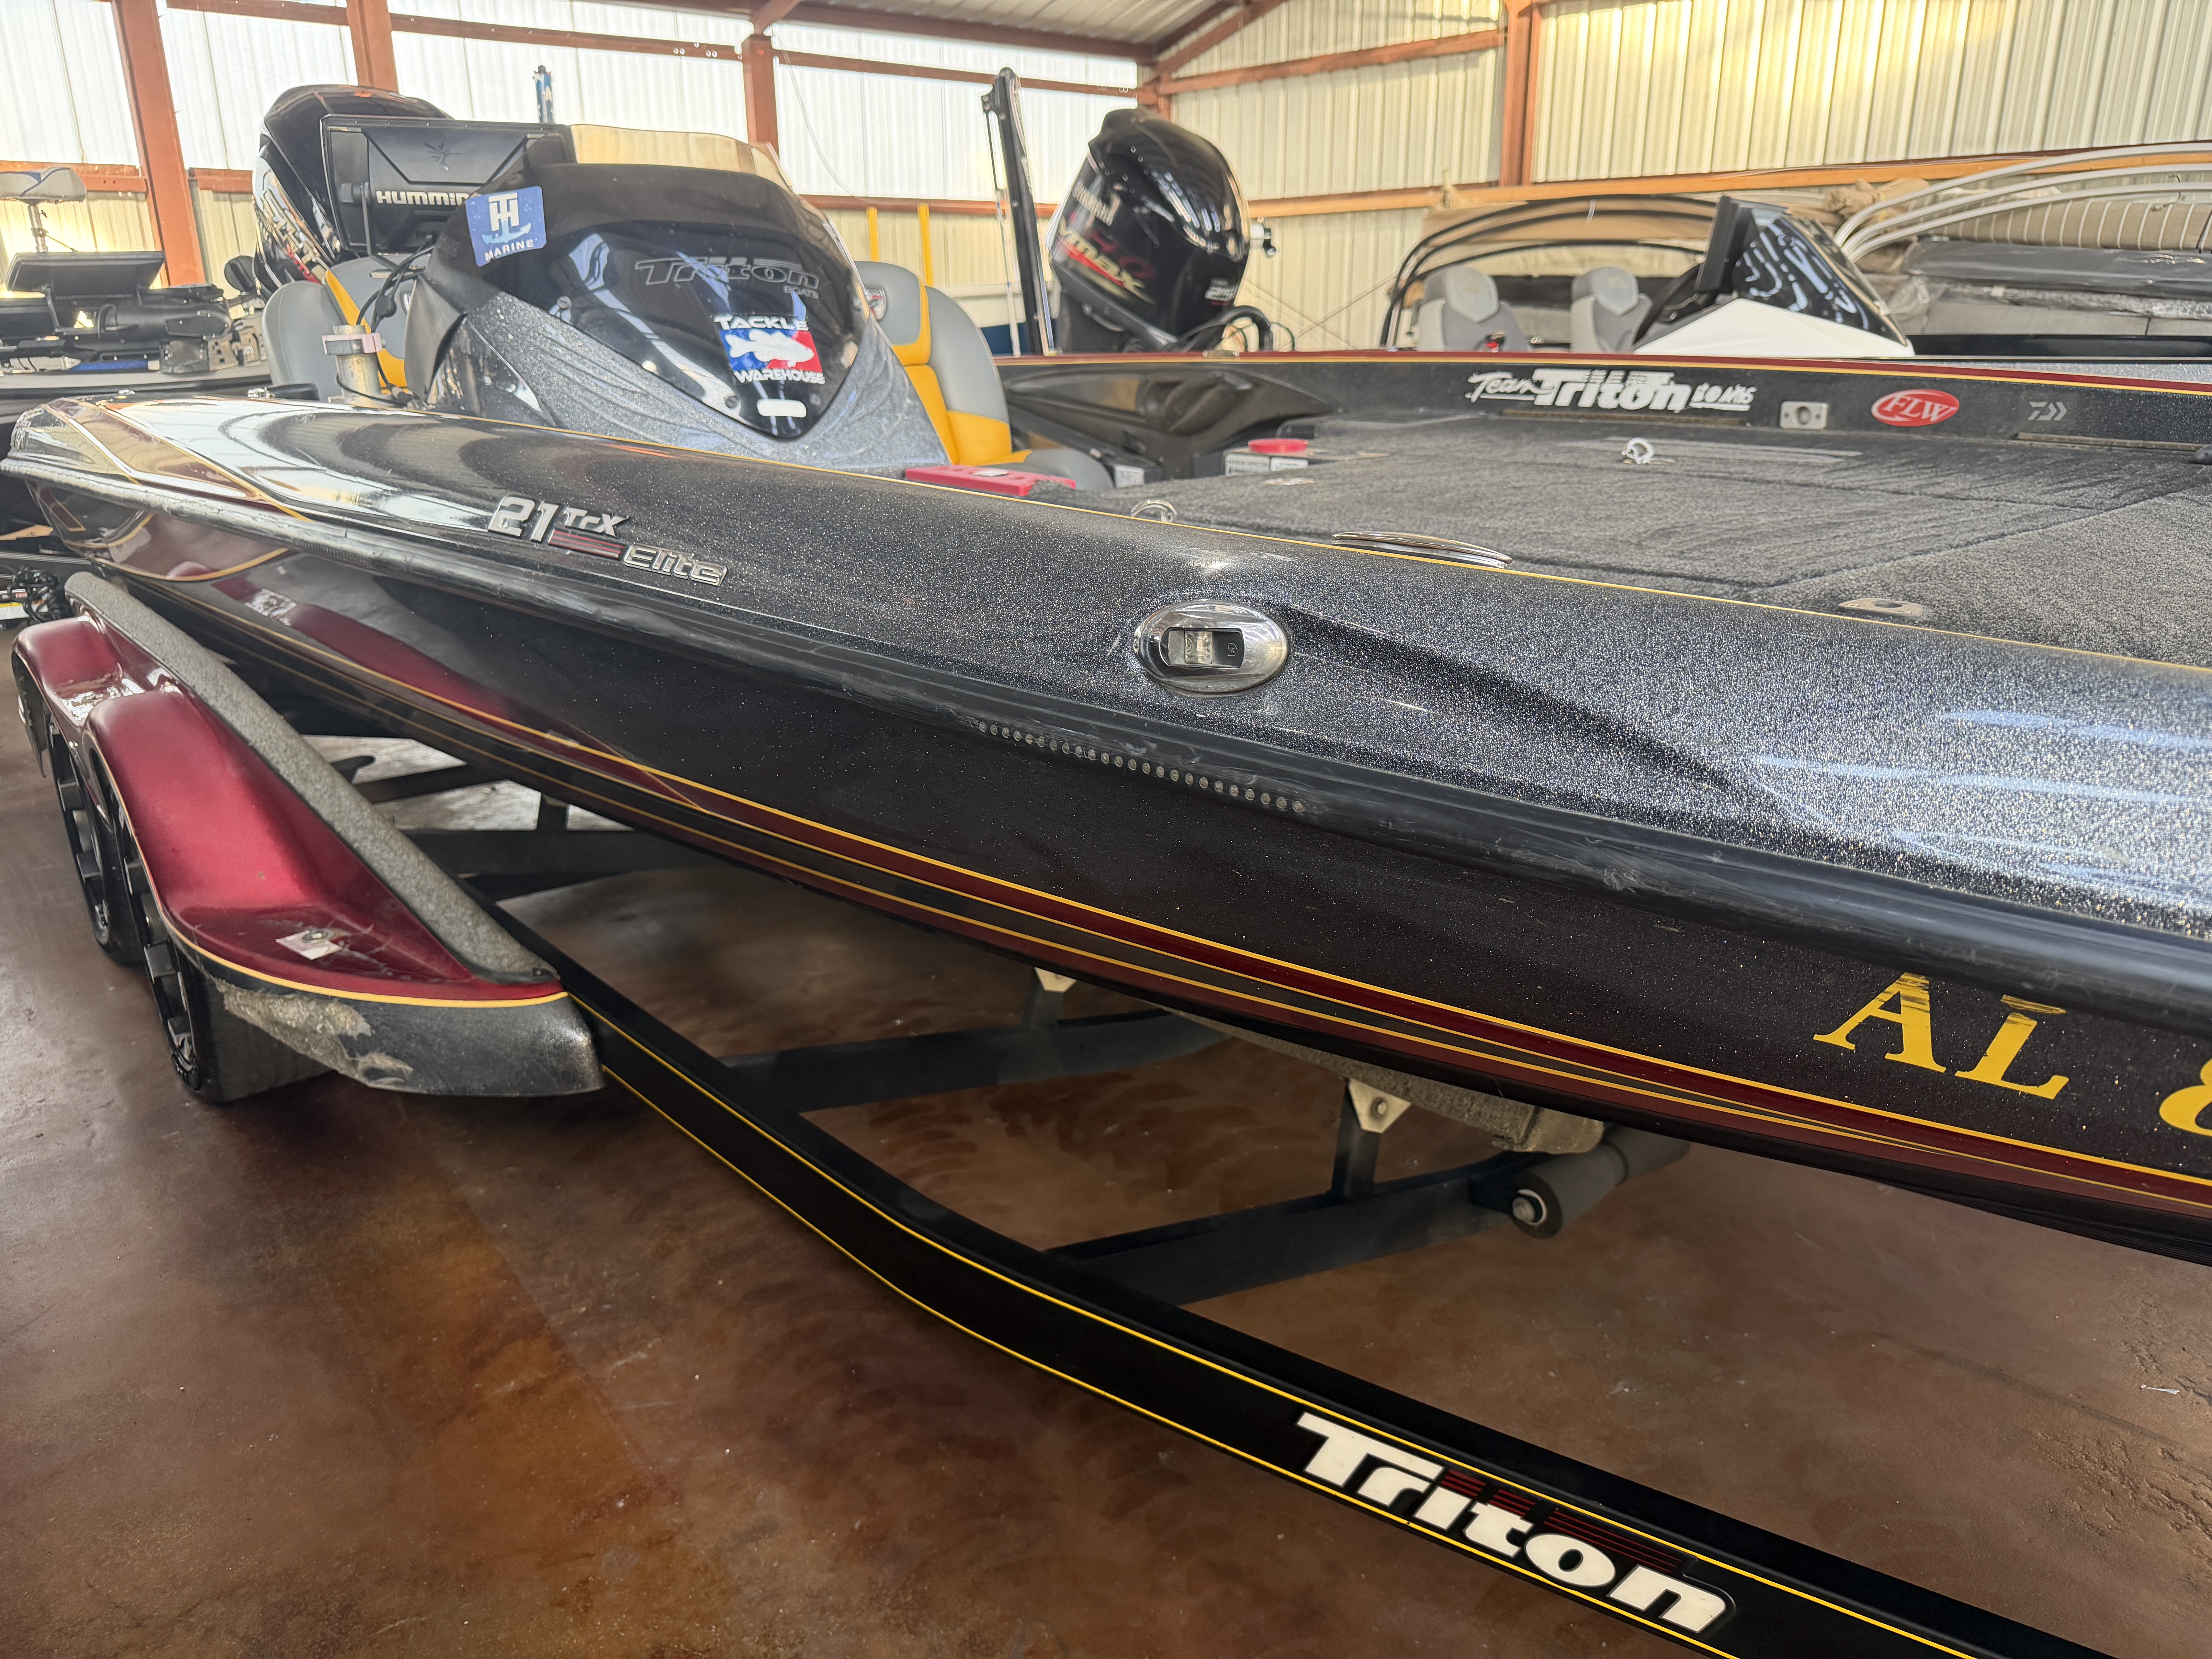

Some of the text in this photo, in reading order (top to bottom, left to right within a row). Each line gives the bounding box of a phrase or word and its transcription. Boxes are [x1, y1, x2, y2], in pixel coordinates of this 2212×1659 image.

[484, 239, 534, 261] MARINE
[635, 256, 819, 289] Triton
[783, 284, 819, 299] BOATS
[714, 315, 809, 331] TACKLE
[734, 370, 825, 384] WAREHOUSE
[1467, 371, 1556, 403] Team
[1532, 368, 1693, 413] Triton
[1884, 393, 1957, 422] FLW
[488, 495, 560, 541] 21
[624, 543, 728, 586] Elite
[1813, 972, 2070, 1099] AL
[1297, 1412, 1726, 1633] Triton
